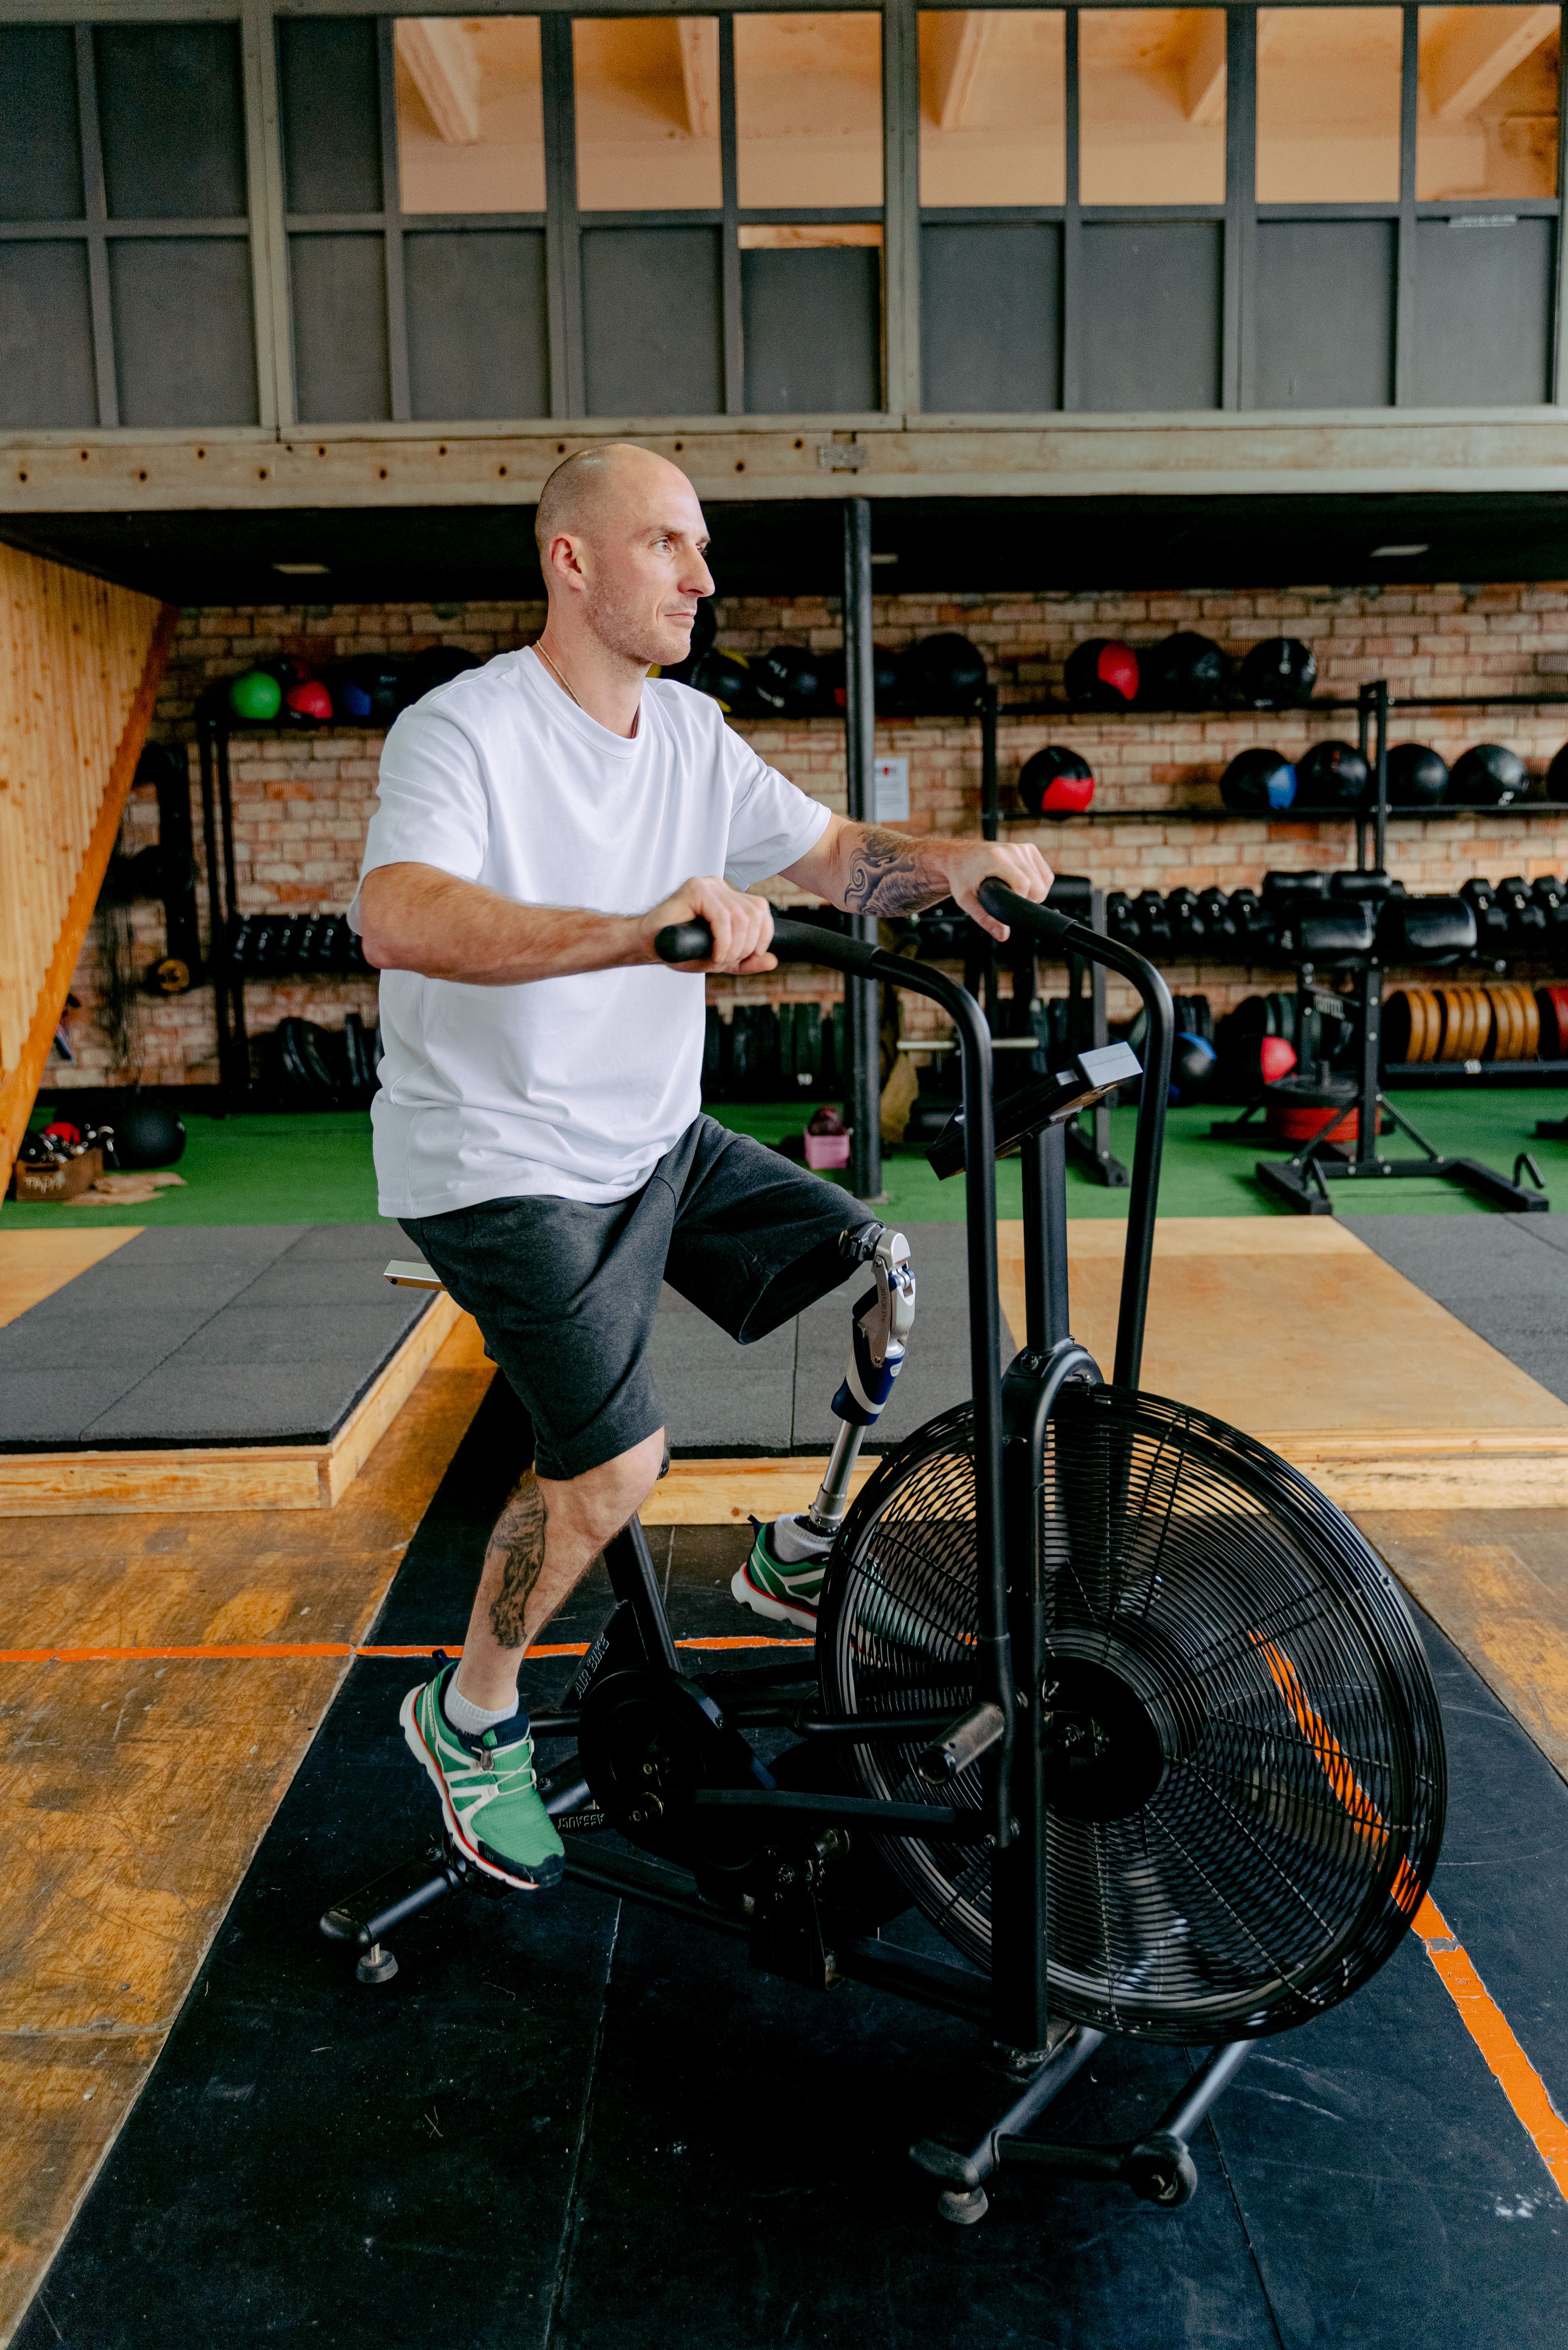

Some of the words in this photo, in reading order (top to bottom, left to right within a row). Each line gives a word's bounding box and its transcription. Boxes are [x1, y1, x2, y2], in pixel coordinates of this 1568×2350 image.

[575, 1668, 592, 1700] AIR
[587, 1632, 610, 1674] BIKE
[557, 1813, 605, 1829] ASSAULT
